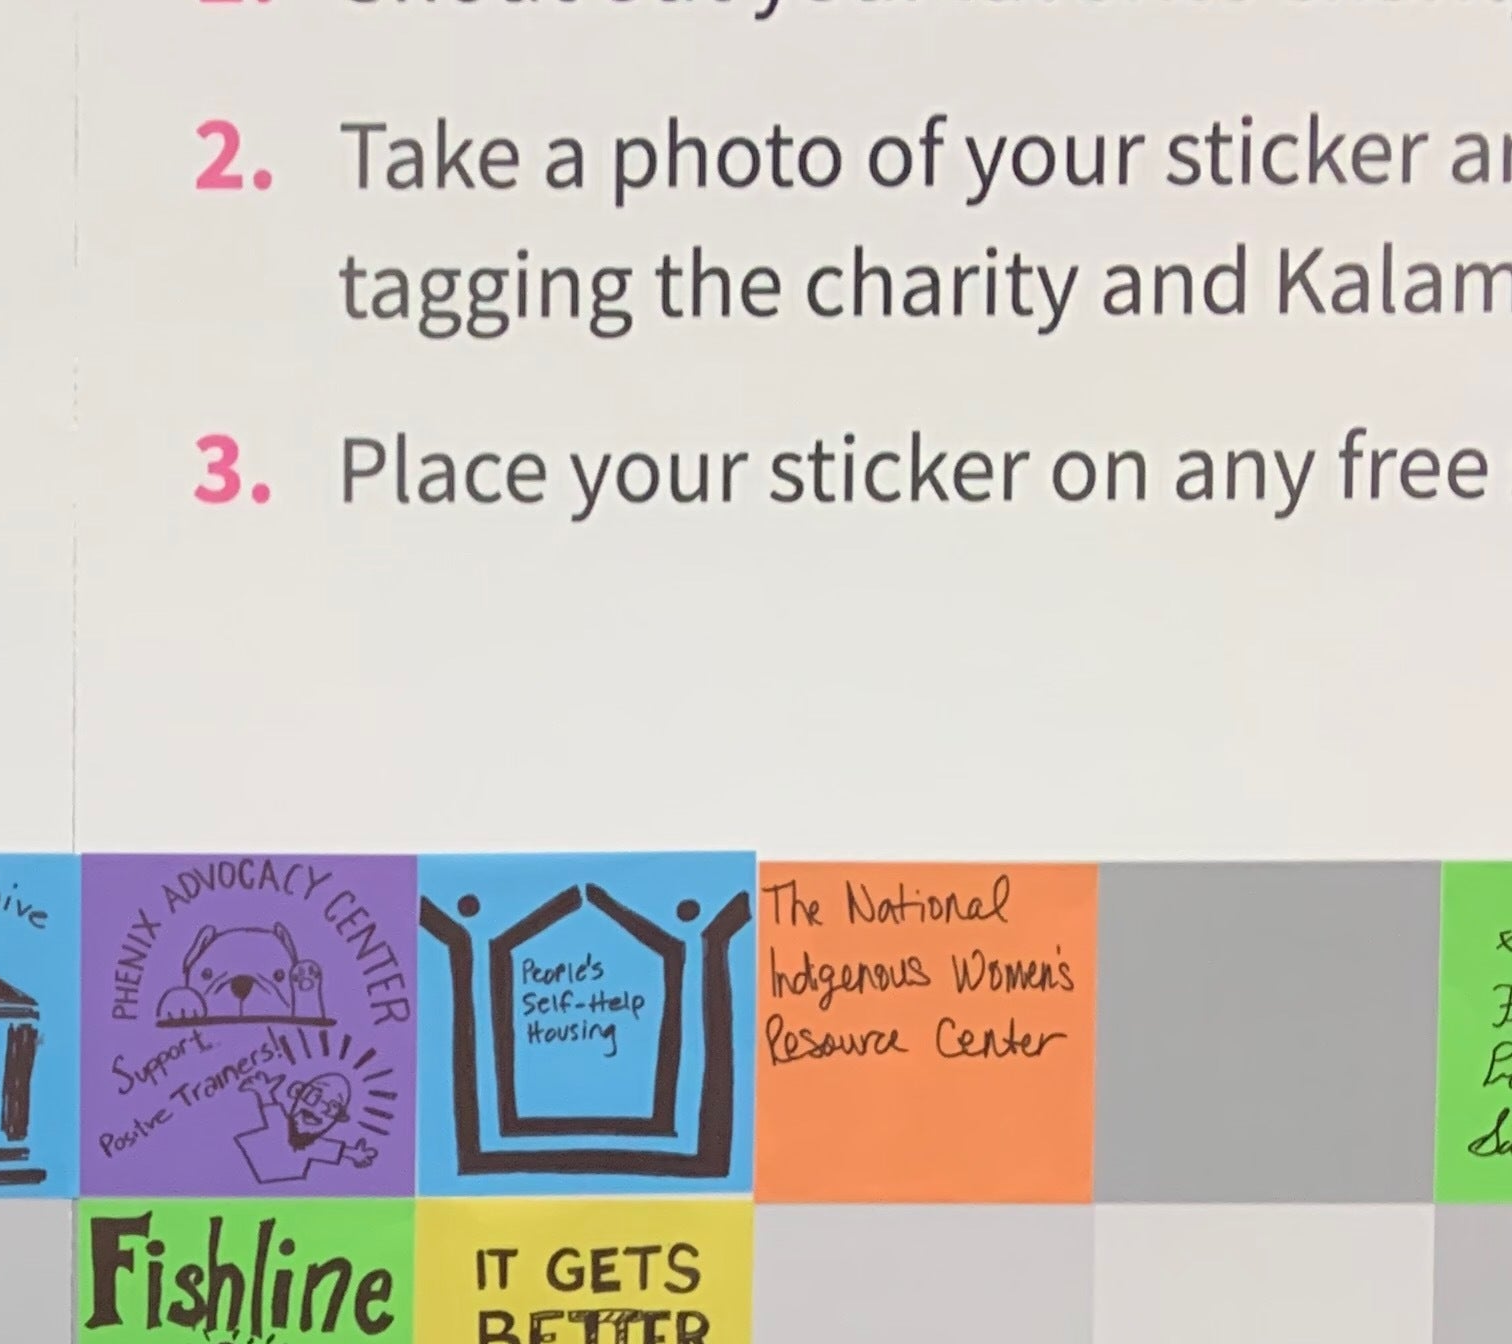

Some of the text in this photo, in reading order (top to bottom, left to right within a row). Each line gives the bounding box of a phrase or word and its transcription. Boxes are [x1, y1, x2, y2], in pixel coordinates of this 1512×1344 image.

[194, 119, 274, 191] 2.
[339, 119, 521, 190] Take
[544, 134, 586, 190] a
[615, 117, 842, 207] photo
[868, 113, 947, 191] of
[966, 127, 1146, 206] your
[1165, 114, 1430, 188] sticker
[339, 249, 633, 339] tagging
[654, 246, 780, 318] the
[805, 245, 1078, 334] charity
[1102, 243, 1247, 315] and
[193, 426, 1489, 522] 3. Place your sticker on any free
[761, 874, 1010, 926] The National
[111, 858, 411, 1025] PHENIX ADVOCACY CENTER
[522, 952, 604, 985] People's
[523, 991, 645, 1019] Self-Help
[770, 944, 1074, 1011] Indigenous Women's
[112, 1029, 212, 1095] Support
[527, 1020, 618, 1058] Housing
[765, 1013, 1068, 1066] Resource Center
[84, 1210, 395, 1339] Fishline
[476, 1241, 701, 1294] IT GETS
